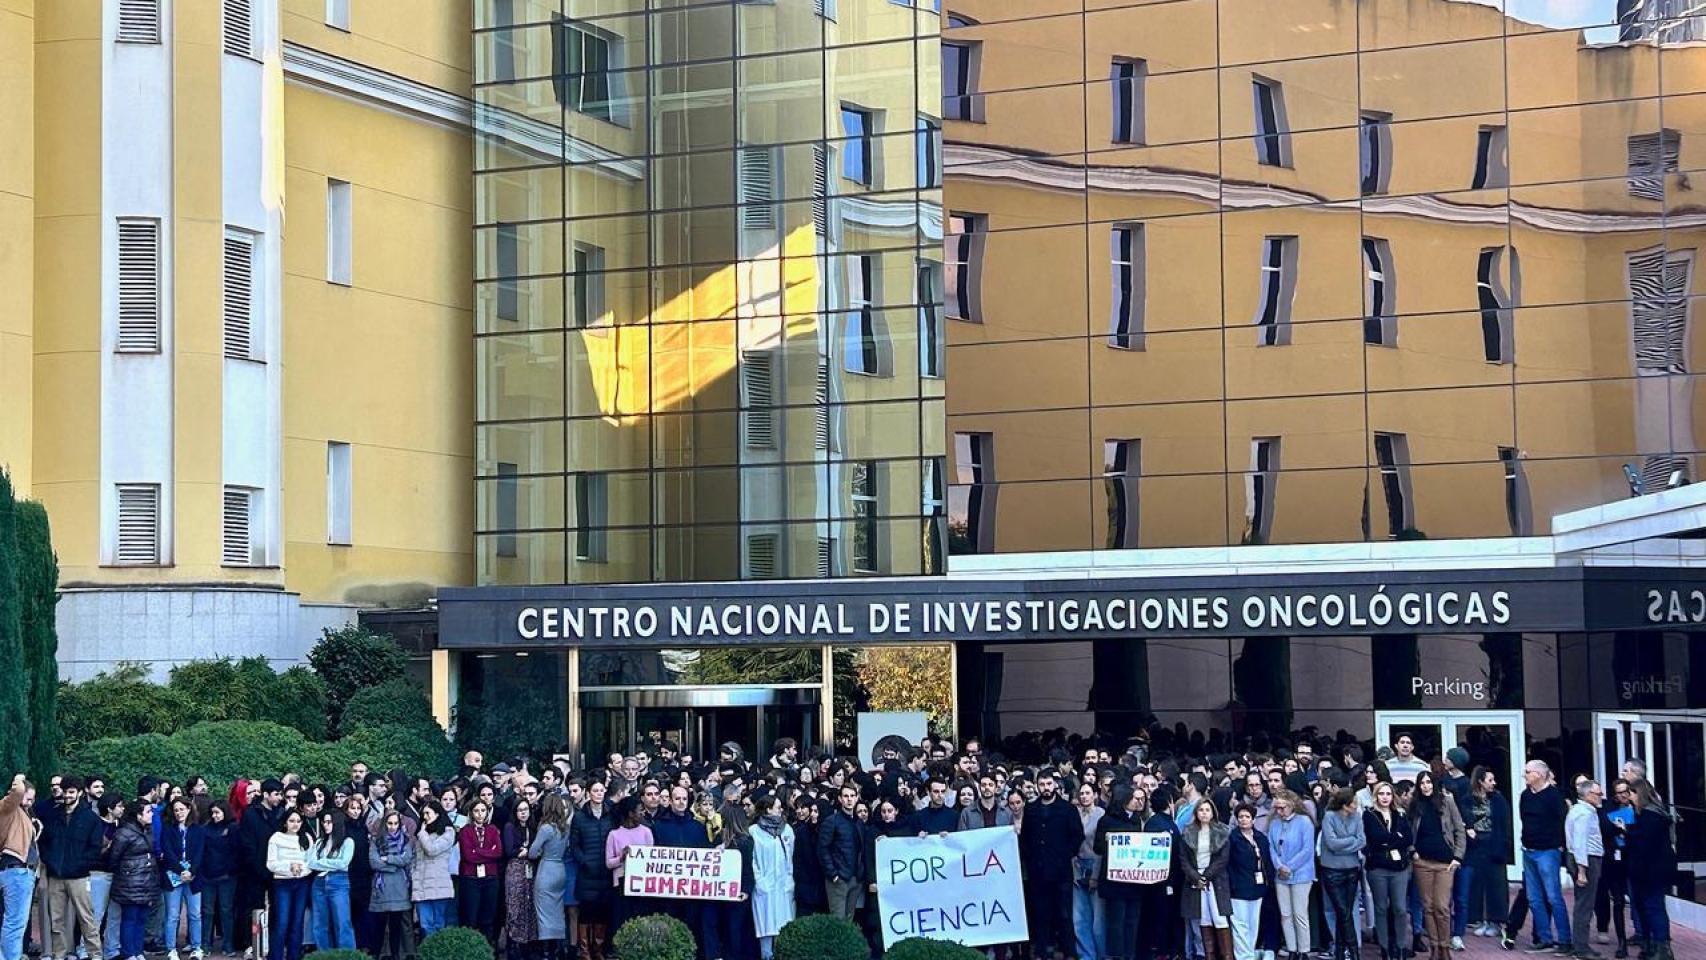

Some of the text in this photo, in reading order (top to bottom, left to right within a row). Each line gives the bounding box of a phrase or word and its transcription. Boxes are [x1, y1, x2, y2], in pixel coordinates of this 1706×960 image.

[517, 584, 1510, 639] CENTRO NACIONAL DE INVESTIGACIONES ONCOLÓGICAS
[1412, 676, 1485, 701] Parking
[1111, 835, 1130, 846] POR
[649, 848, 698, 861] CIENCIA
[703, 851, 722, 864] ES
[890, 849, 1006, 885] POR LA
[645, 862, 721, 877] NUESTRO
[889, 899, 1011, 935] CIENCIA
